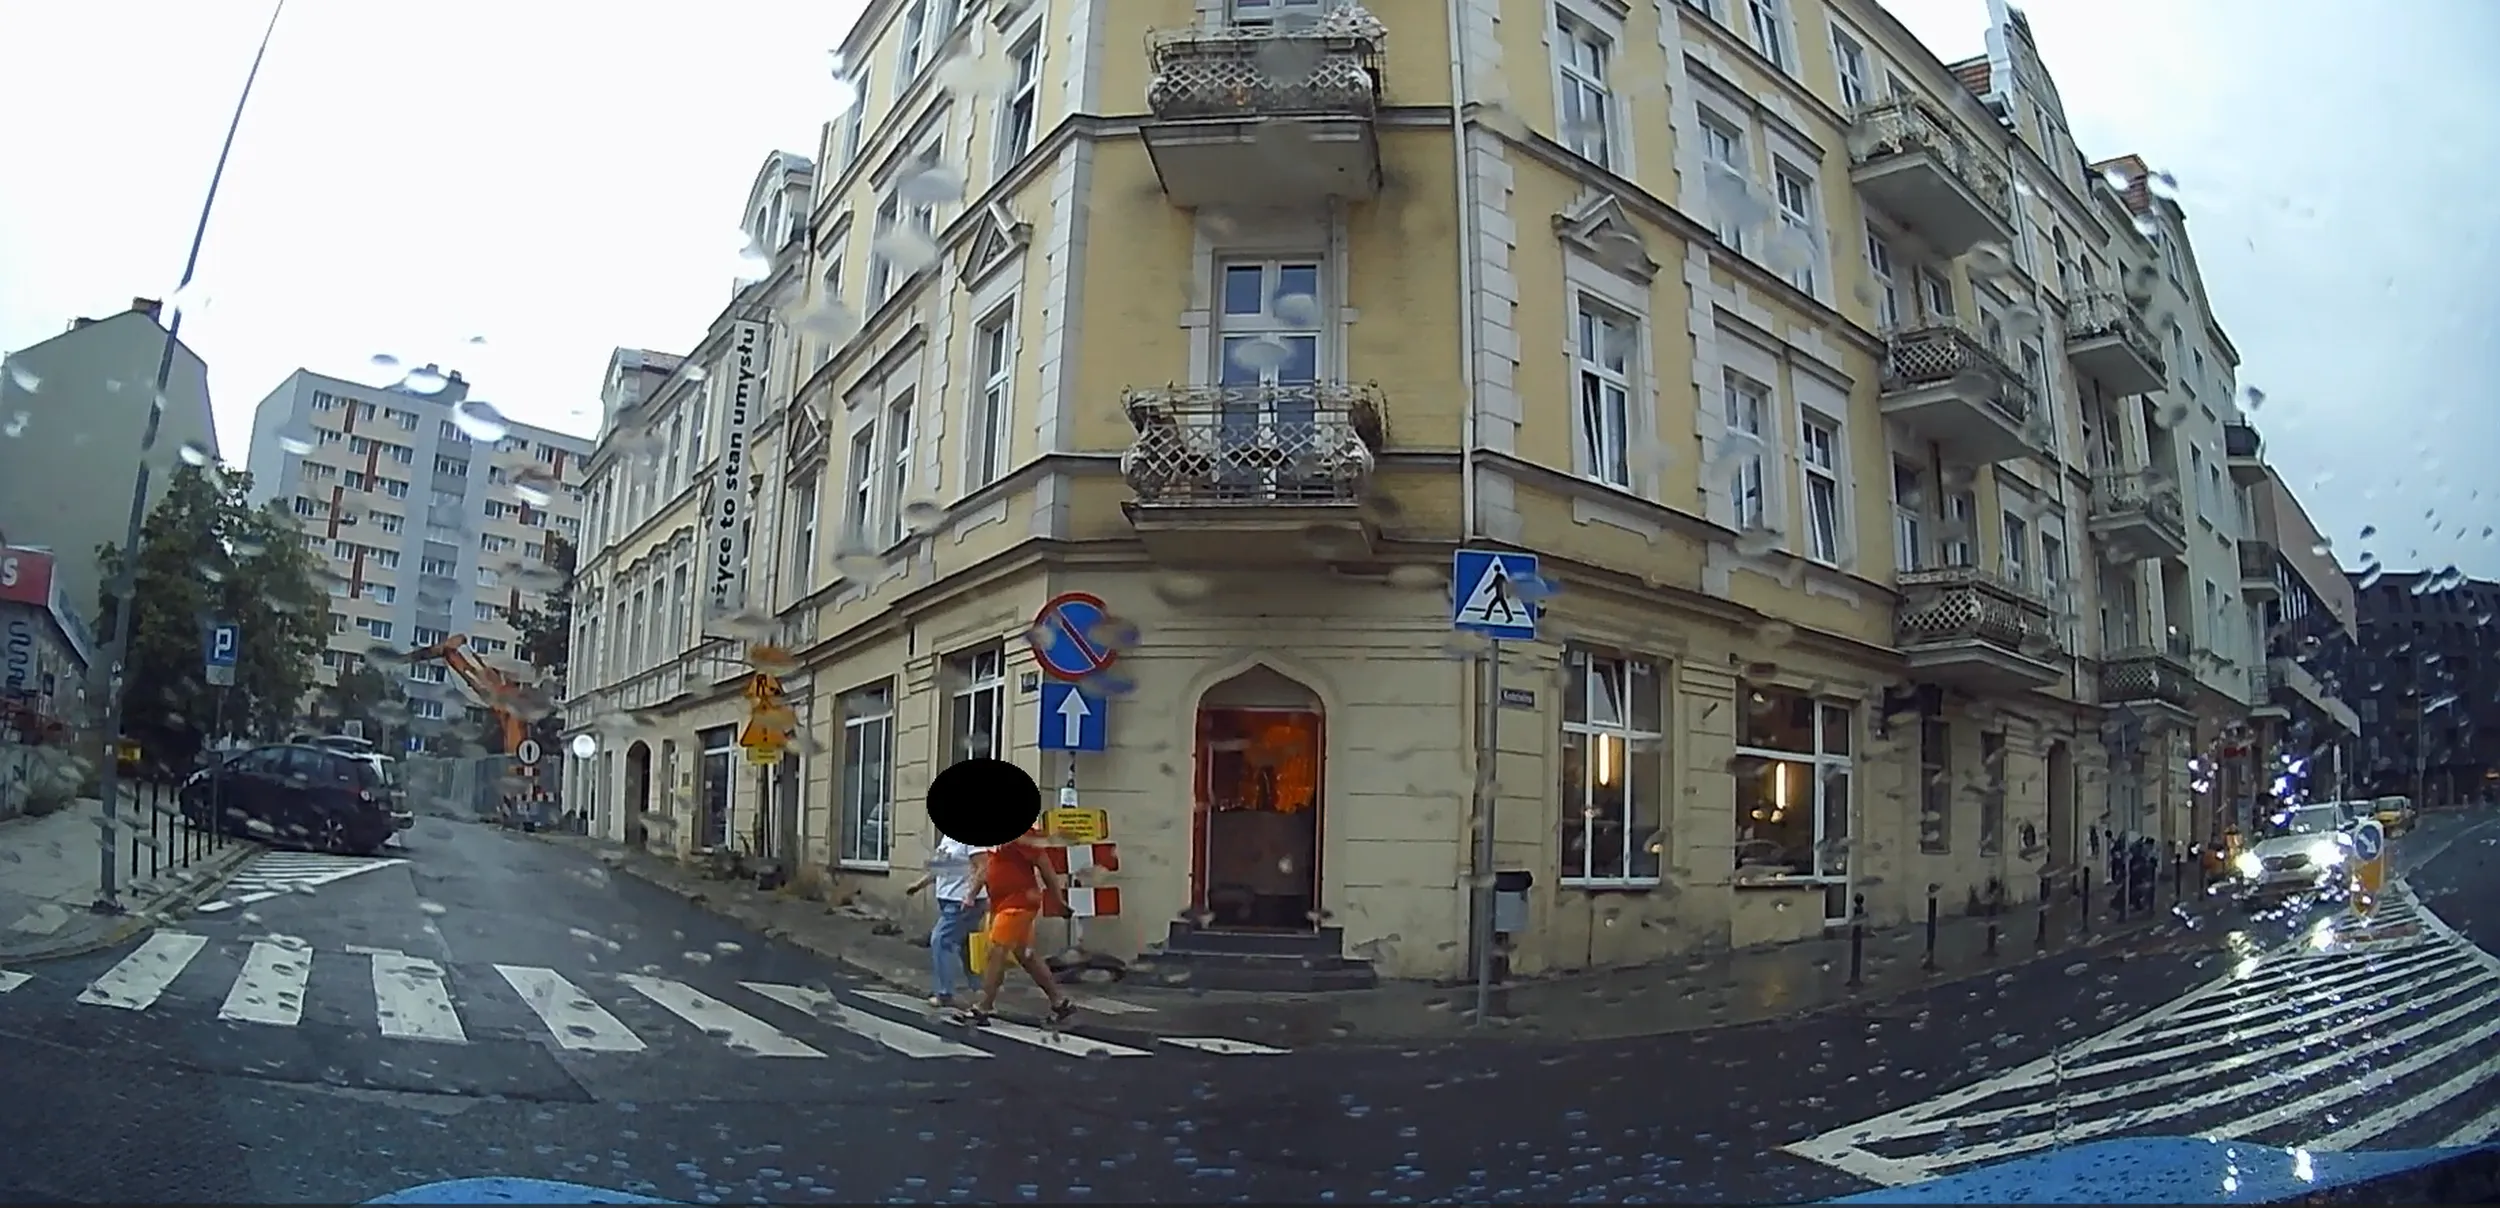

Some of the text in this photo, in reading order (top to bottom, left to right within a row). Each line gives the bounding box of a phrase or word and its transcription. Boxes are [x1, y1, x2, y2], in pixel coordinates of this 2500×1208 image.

[733, 327, 755, 425] umysłu
[726, 432, 742, 491] stan
[720, 498, 735, 529] to
[215, 628, 232, 659] P
